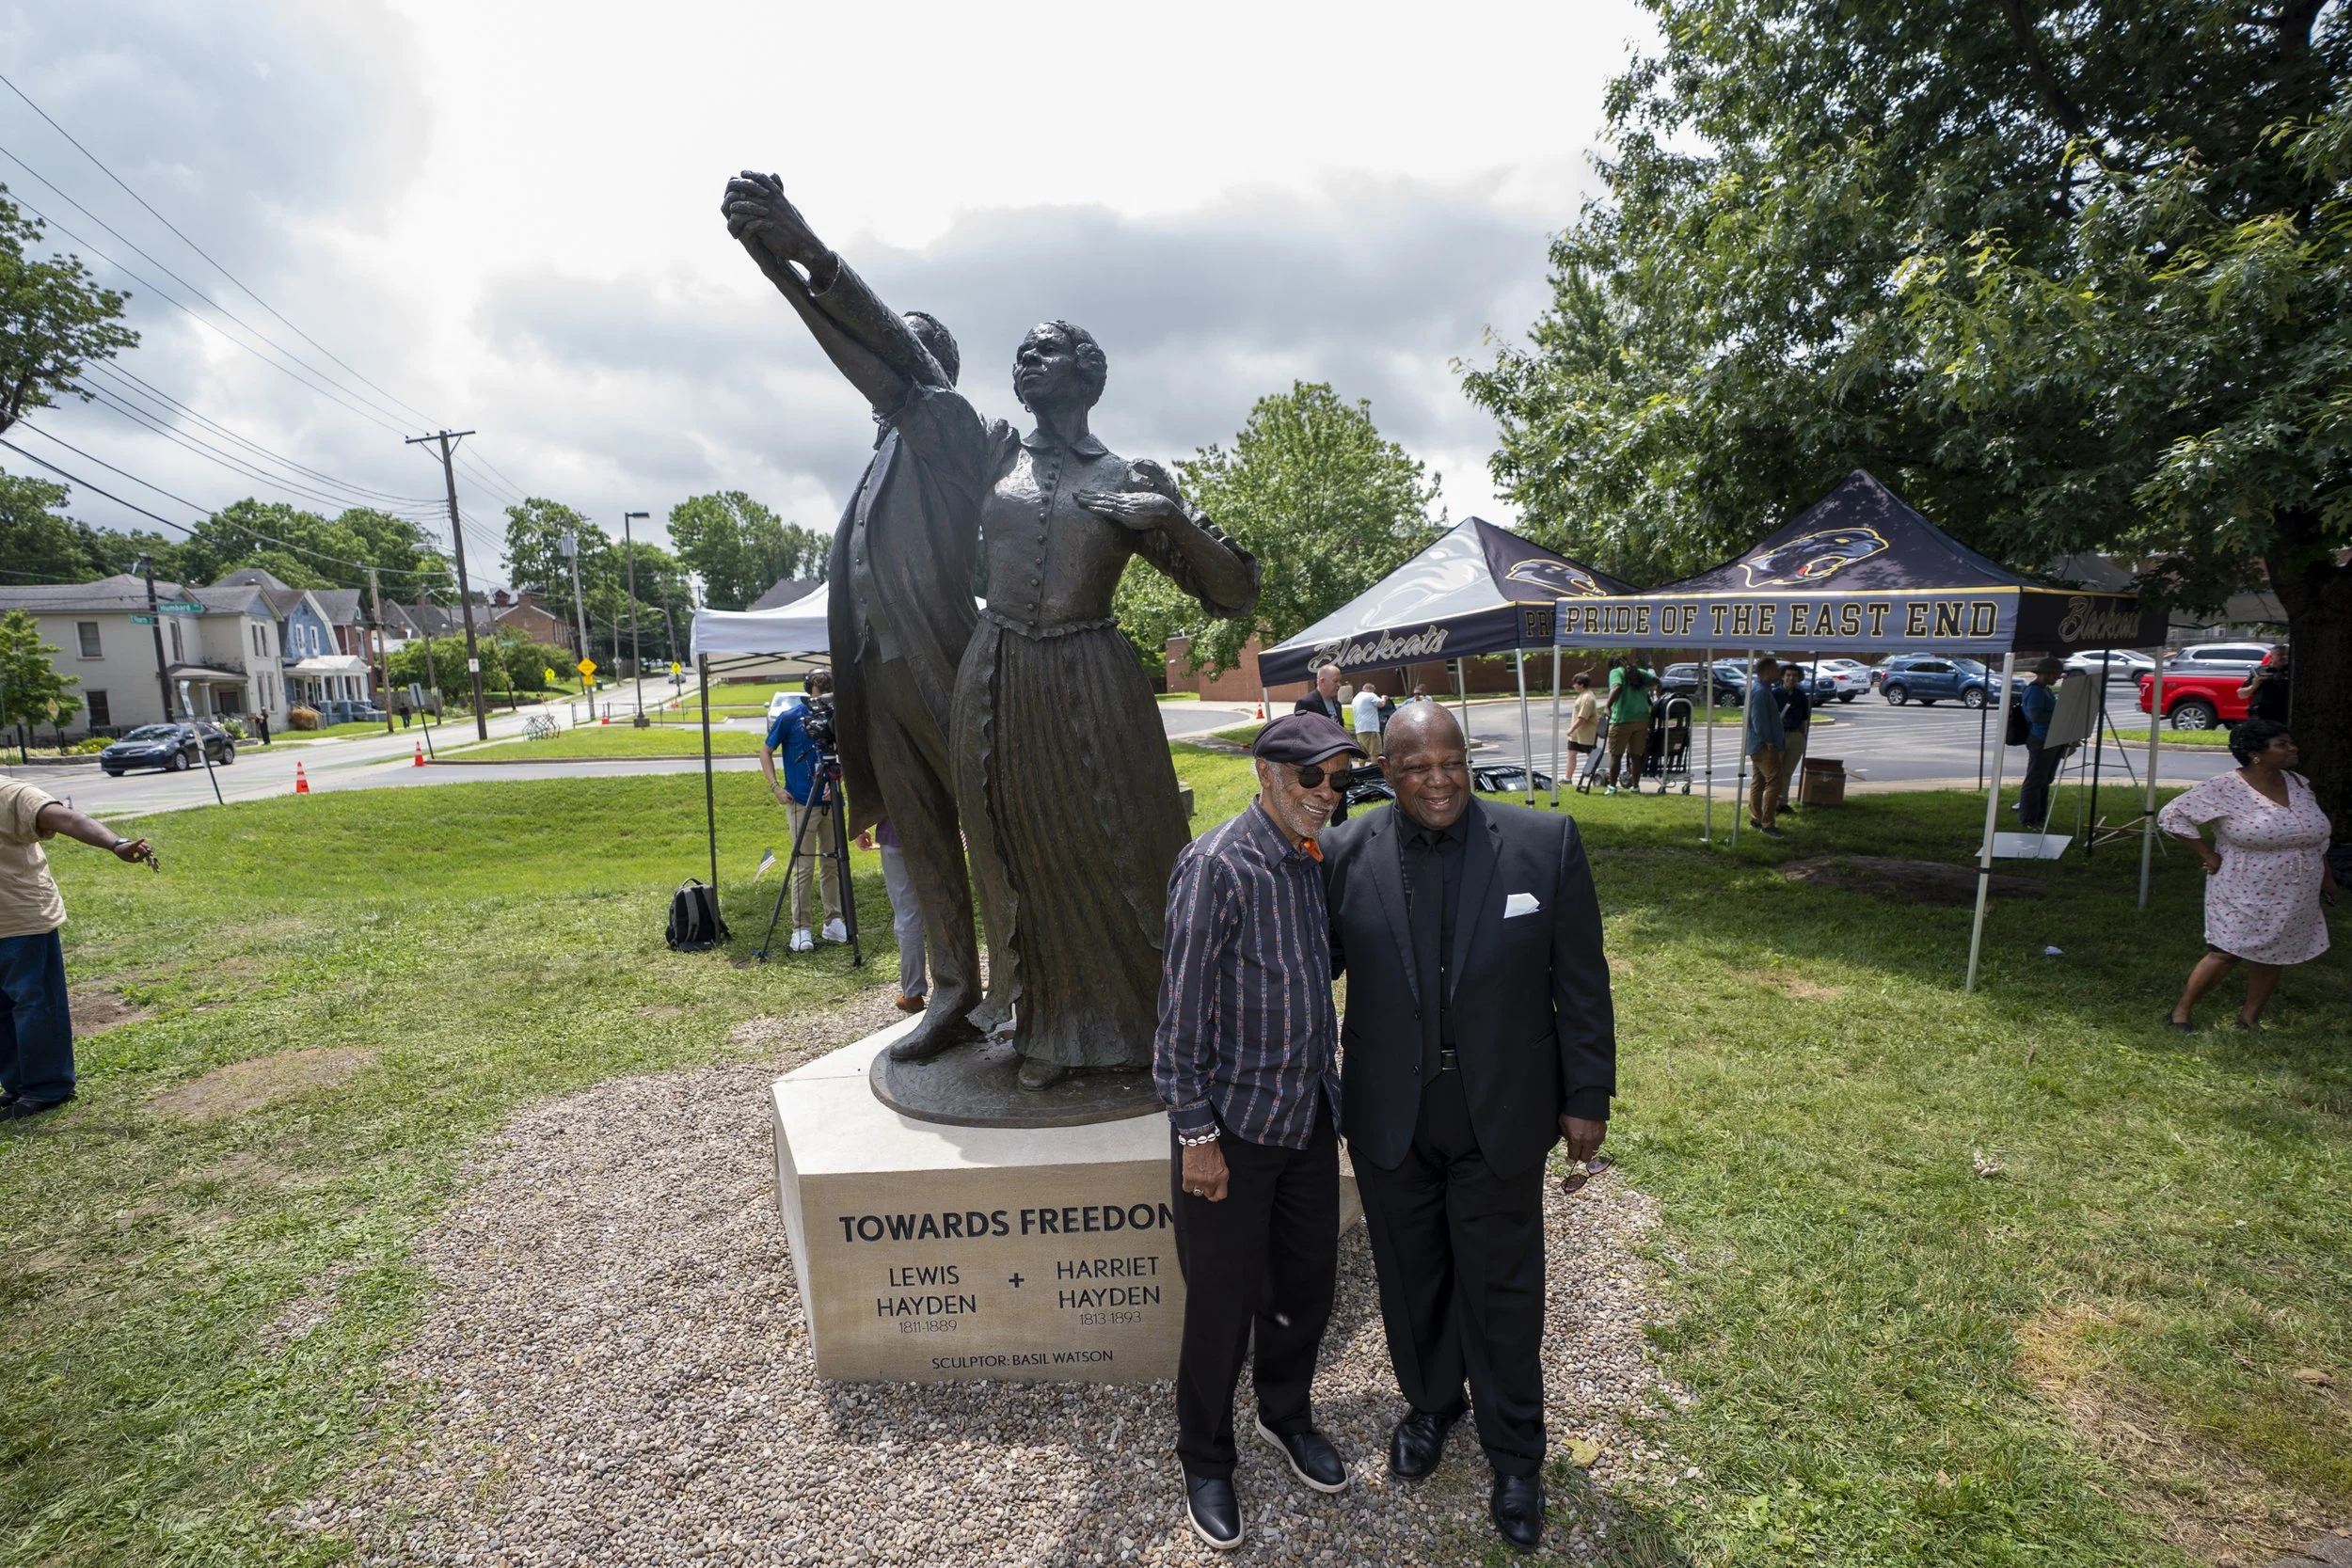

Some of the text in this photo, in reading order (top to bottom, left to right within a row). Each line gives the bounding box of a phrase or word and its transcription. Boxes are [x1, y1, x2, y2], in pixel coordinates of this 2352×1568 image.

[1565, 601, 1998, 639] PRIDE OF THE EAST END
[1308, 625, 1449, 673] Blackcats
[839, 1210, 1009, 1243] TOWARDS
[889, 1265, 960, 1287] LEWIS
[1057, 1257, 1159, 1279] HARRIET
[877, 1294, 977, 1317] HAYDEN
[1058, 1286, 1160, 1308] HAYDEN
[899, 1320, 958, 1333] 1811-1889
[1080, 1311, 1141, 1325] 1813-1893
[931, 1350, 1114, 1370] SCULPTOR: BASIL WATSON
